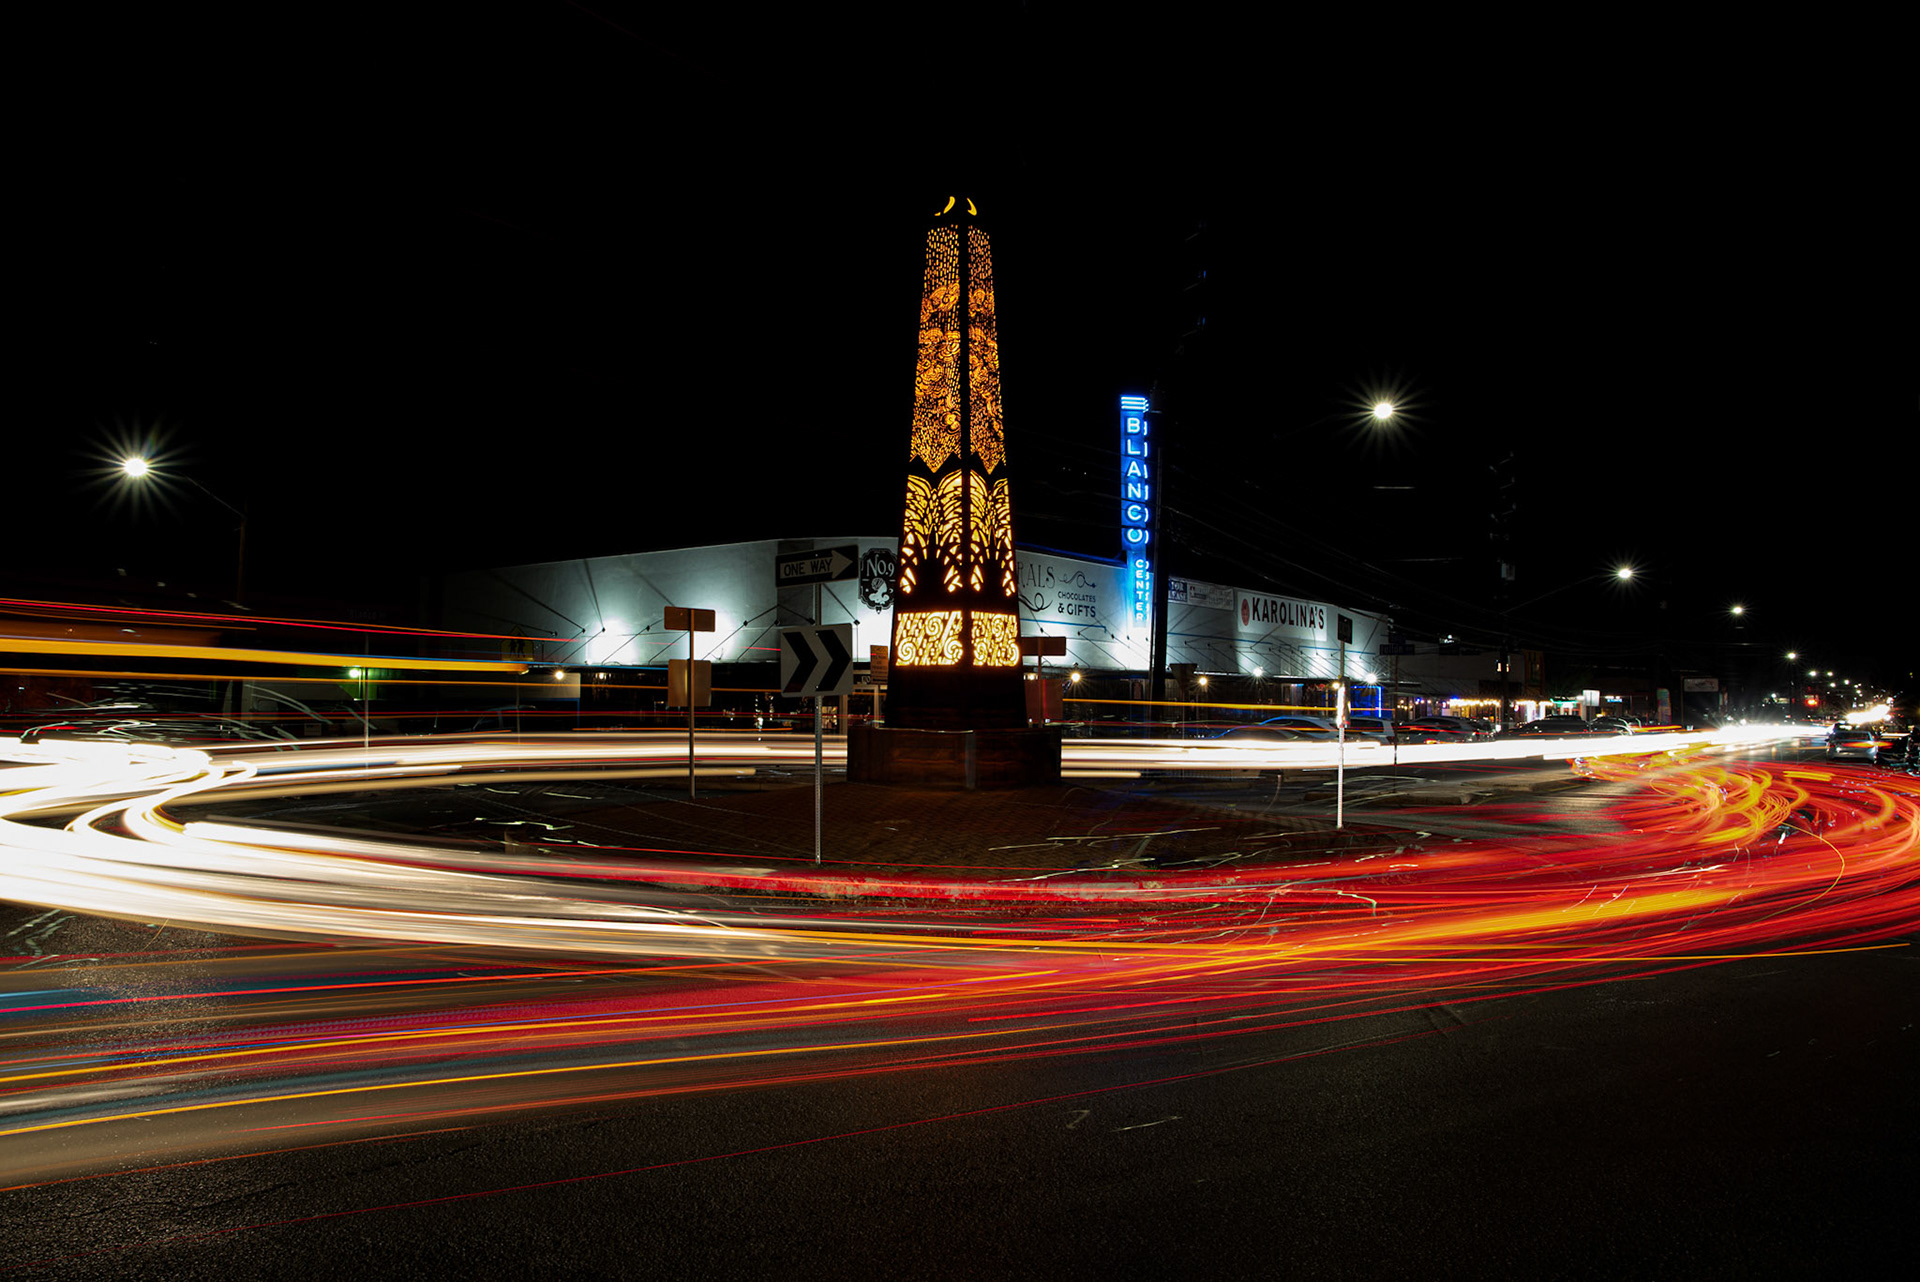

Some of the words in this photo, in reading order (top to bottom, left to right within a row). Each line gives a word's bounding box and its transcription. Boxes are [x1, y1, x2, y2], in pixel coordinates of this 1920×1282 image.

[1126, 416, 1142, 544] BLANCO
[784, 562, 805, 577] ONE
[810, 558, 834, 573] WAY
[1057, 590, 1097, 603] CHOCOLATES
[1135, 558, 1145, 621] CENTER
[1057, 602, 1065, 614] &
[1066, 602, 1097, 618] GIFTS
[1252, 597, 1325, 630] KAROLINA'S
